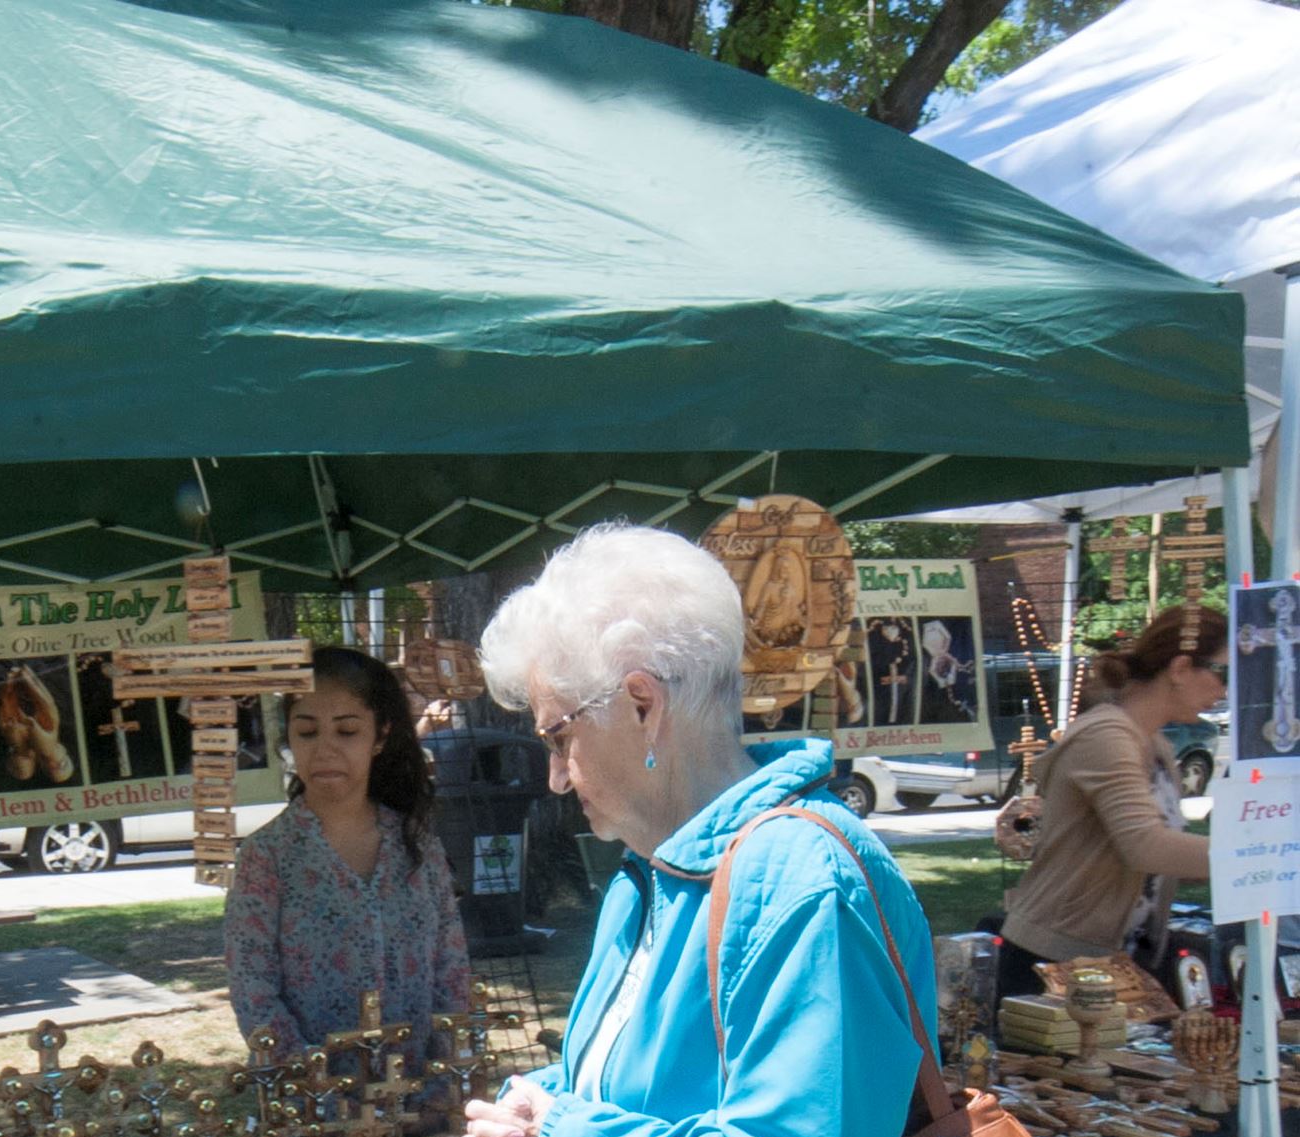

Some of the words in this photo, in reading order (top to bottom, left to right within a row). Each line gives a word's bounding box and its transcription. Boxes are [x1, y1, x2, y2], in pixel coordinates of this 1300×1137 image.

[857, 565, 909, 598] Holy
[911, 565, 966, 590] Land
[10, 593, 78, 627] The
[85, 588, 159, 626] Holy
[12, 637, 61, 654] Olive
[67, 632, 109, 651] Tree
[116, 626, 176, 650] Wood
[845, 732, 860, 747] &
[866, 730, 942, 747] Bethlehem
[54, 796, 73, 812] &
[82, 780, 193, 810] Bethlehe
[1239, 800, 1292, 822] Free
